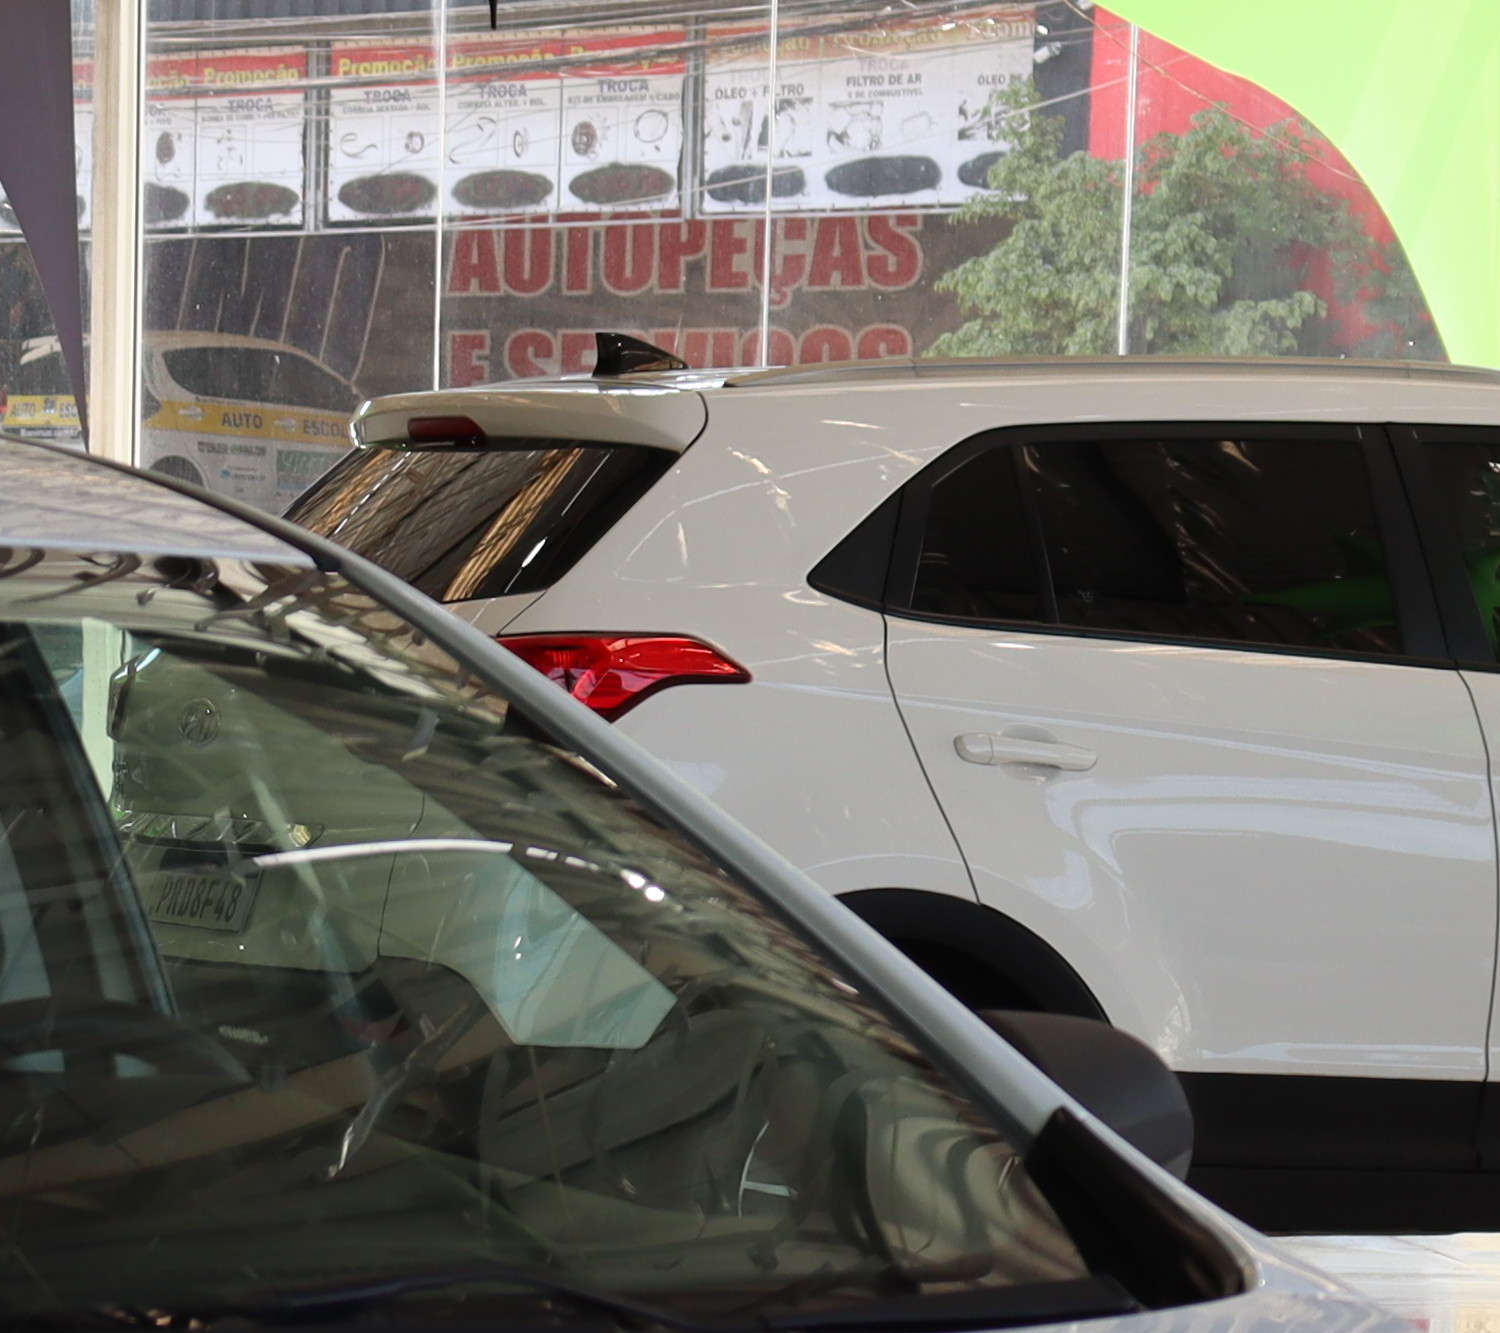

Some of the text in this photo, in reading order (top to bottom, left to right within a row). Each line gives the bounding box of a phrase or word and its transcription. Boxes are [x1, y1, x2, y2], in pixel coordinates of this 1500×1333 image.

[597, 79, 649, 93] TROCA
[846, 73, 922, 87] FILTRO DE AR
[479, 84, 527, 99] TROCA
[763, 84, 804, 97] FTRO
[446, 208, 924, 310] AUTOPEÇAS
[10, 402, 36, 418] AUTO
[221, 412, 349, 438] AUTO ESCOL
